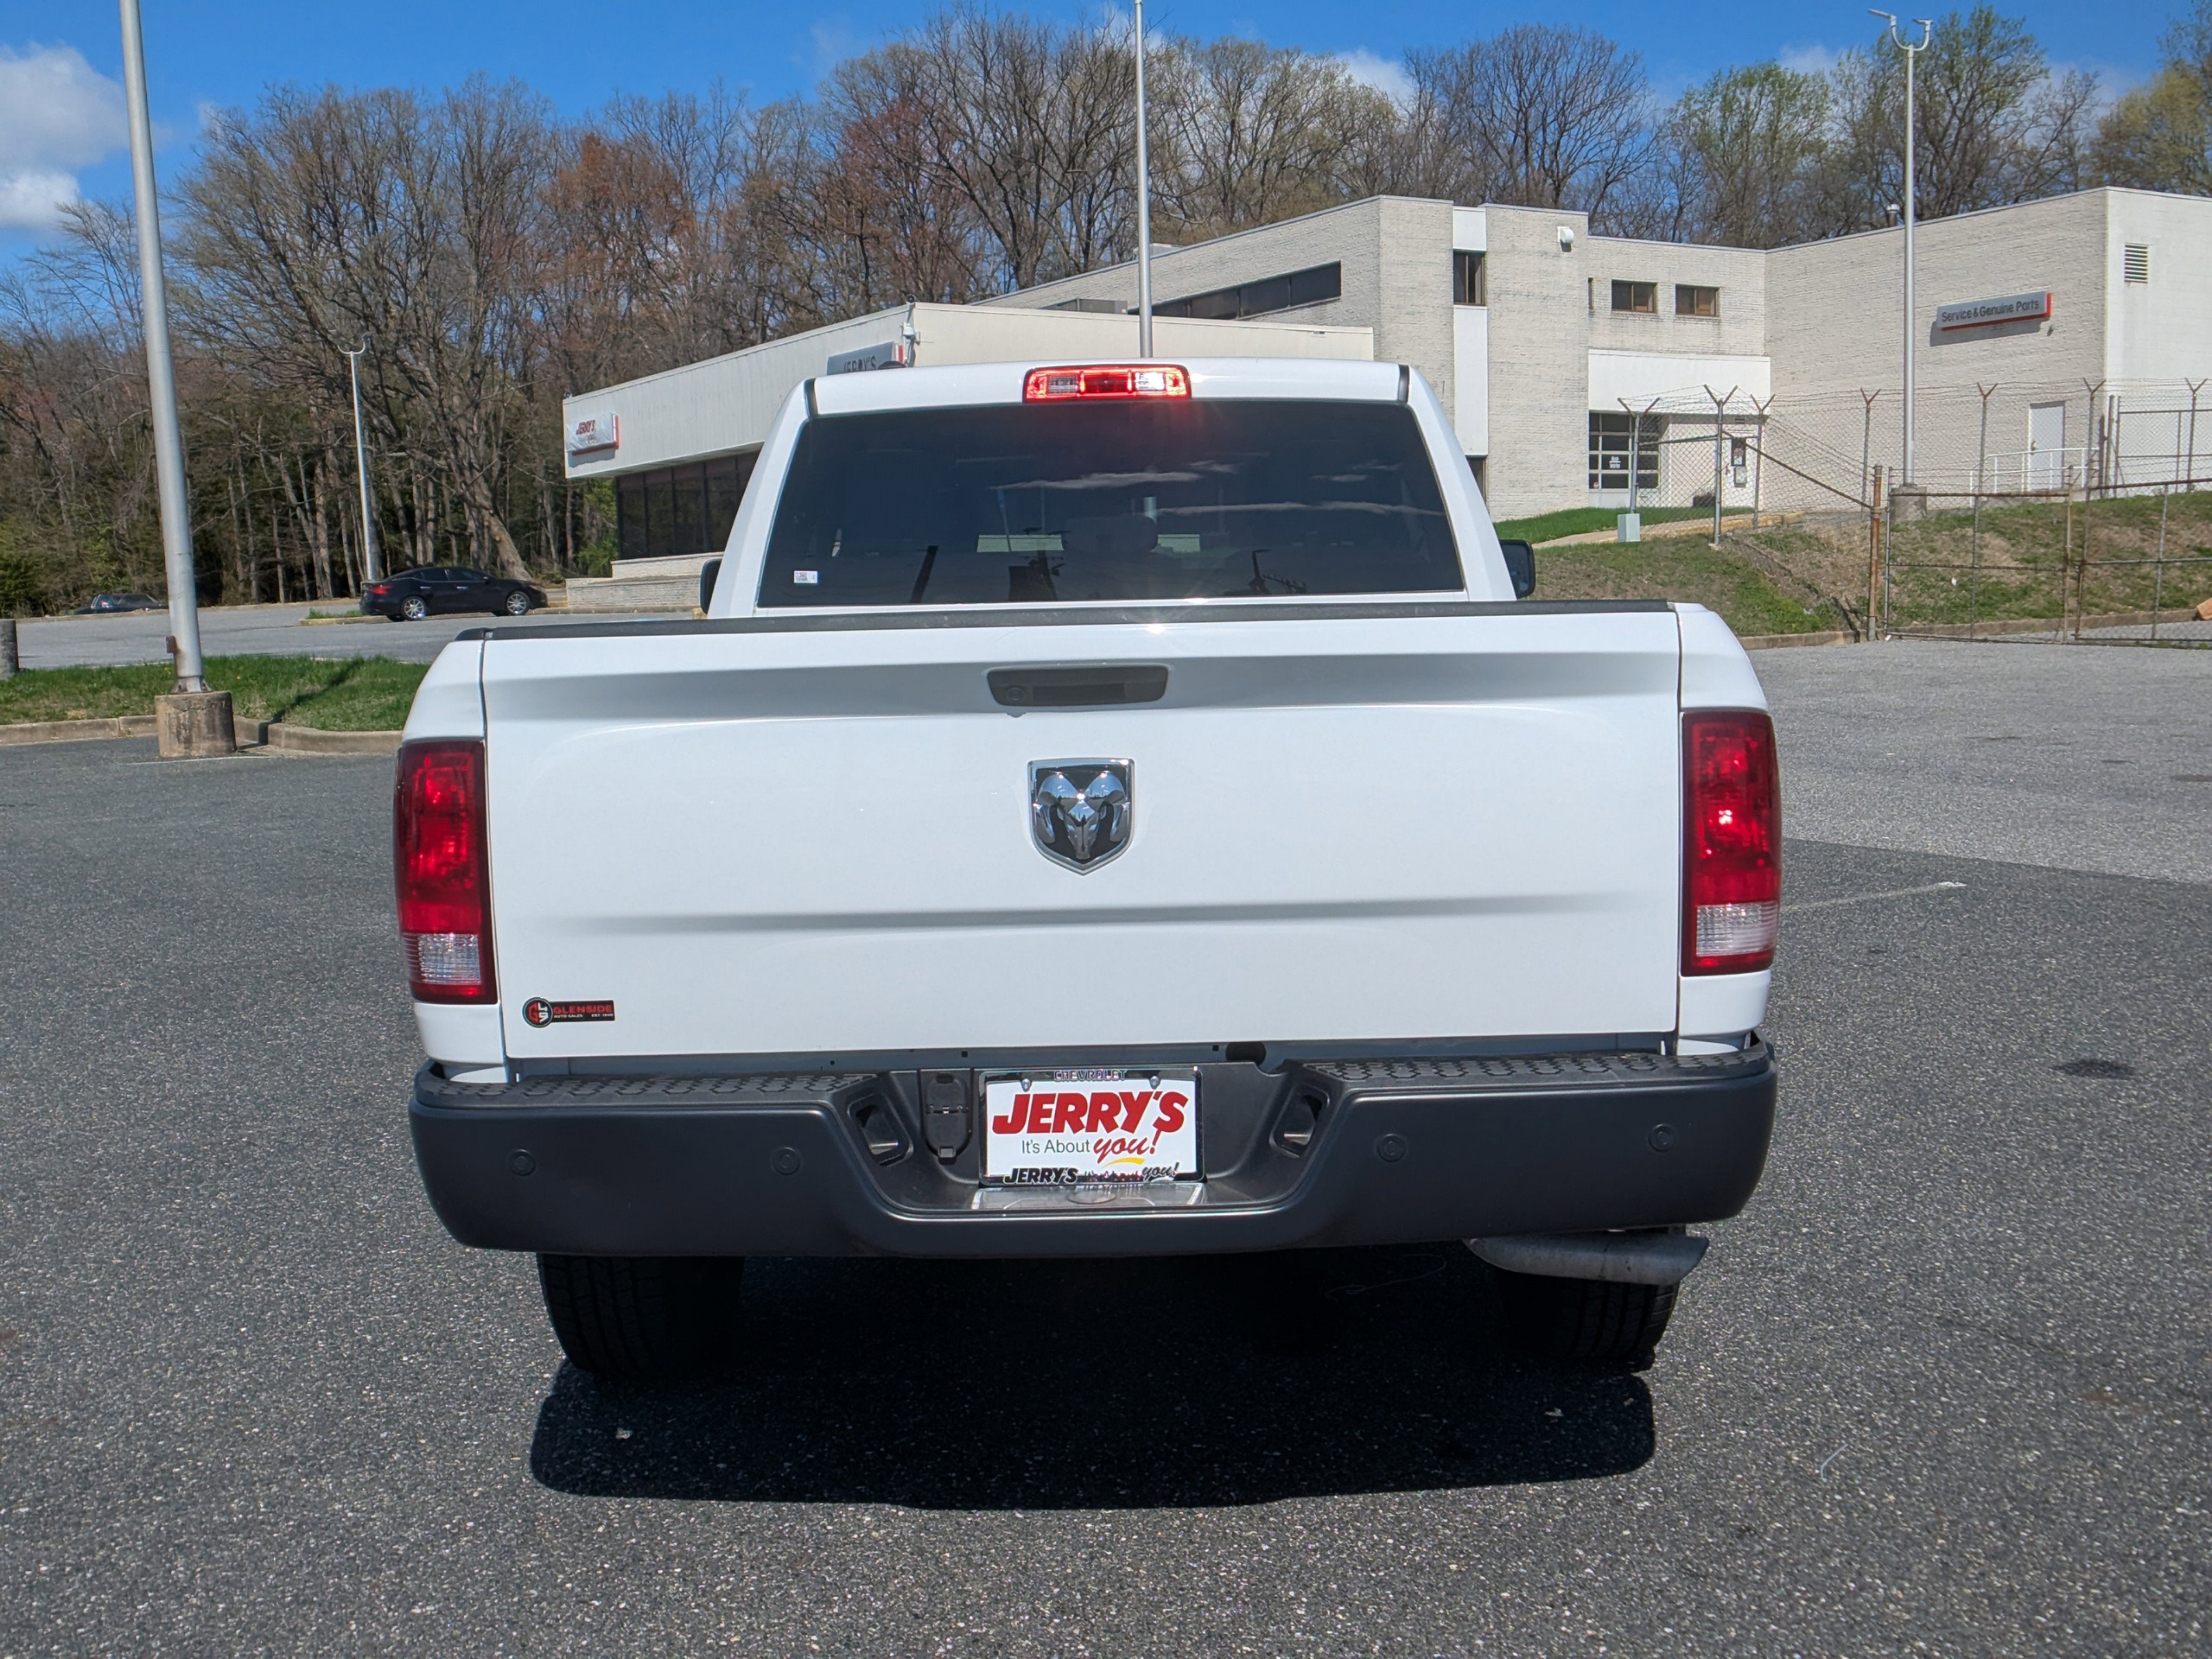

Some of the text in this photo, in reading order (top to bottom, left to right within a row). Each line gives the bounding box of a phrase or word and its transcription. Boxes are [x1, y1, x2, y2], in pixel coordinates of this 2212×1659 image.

[1942, 300, 2039, 322] Service & Genuine Parts
[553, 1004, 613, 1014] GLENSIDE
[1054, 1069, 1127, 1081] CHEVROLET
[992, 1091, 1189, 1134] JERRY'S
[1022, 1131, 1162, 1164] It's About you!
[1003, 1167, 1078, 1184] JERRY'S
[1142, 1162, 1180, 1181] you!
